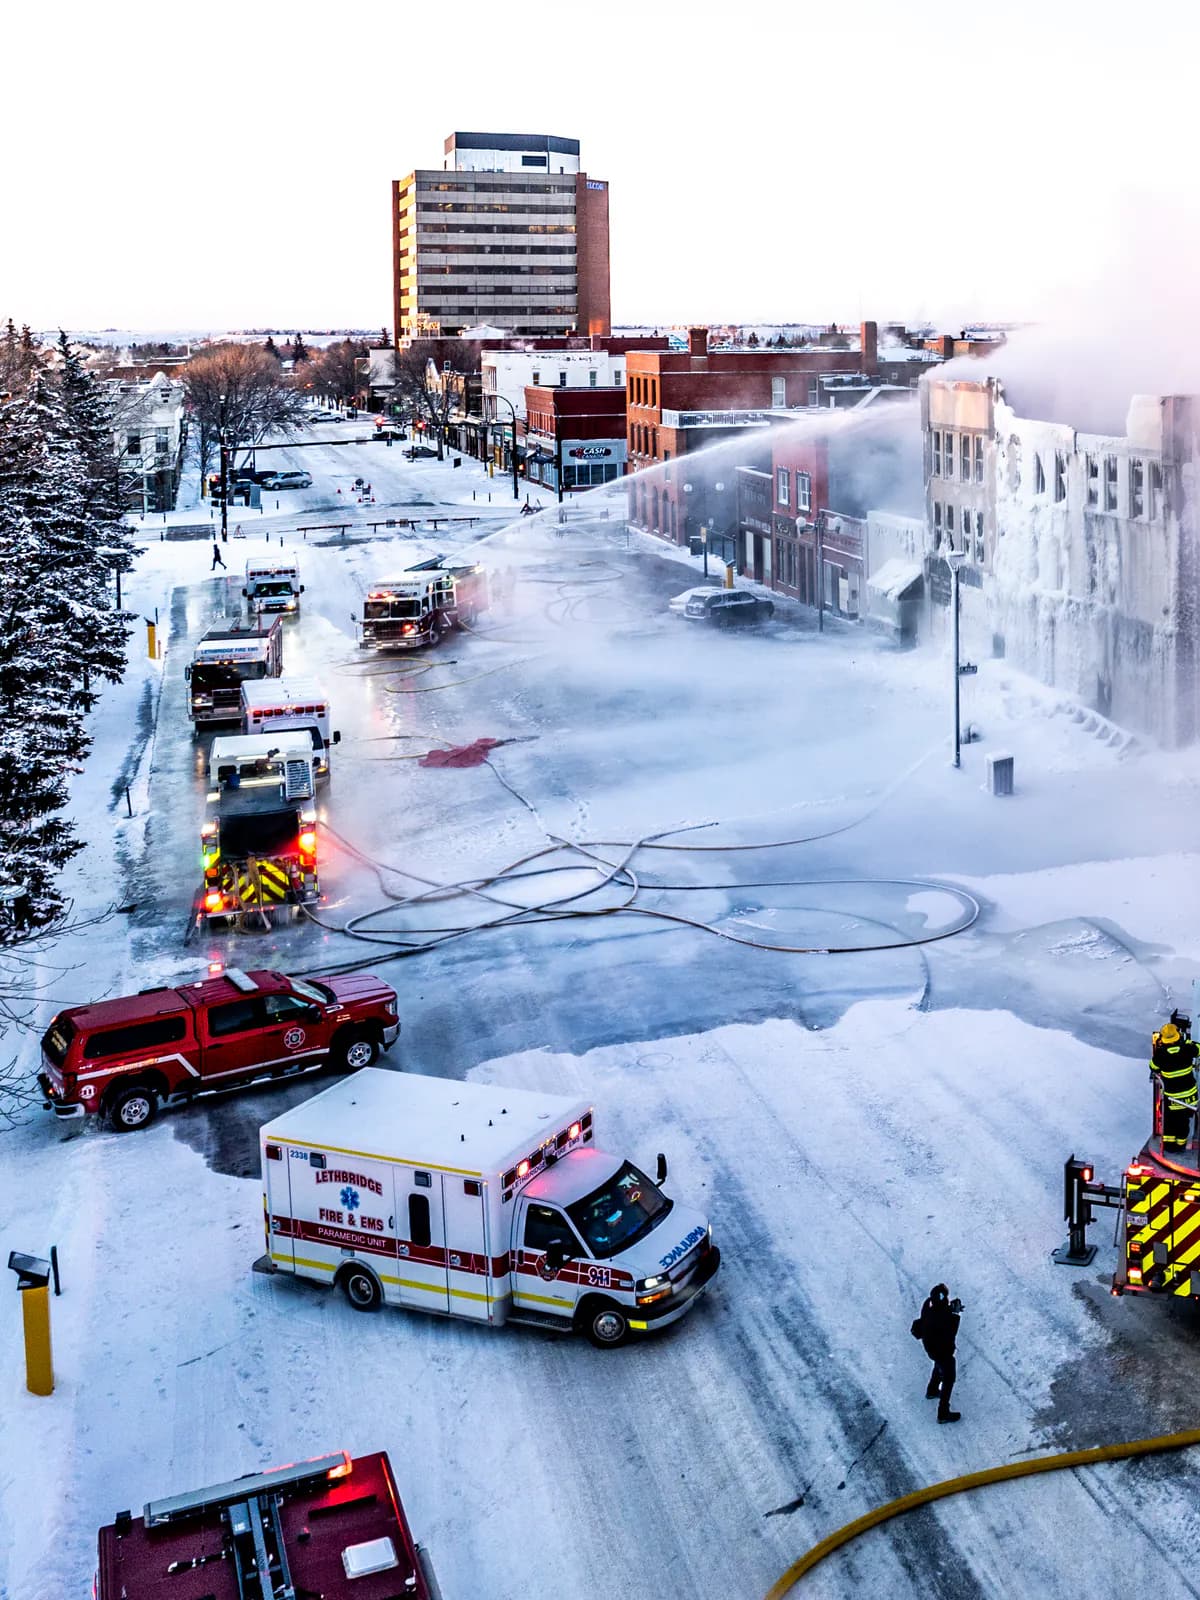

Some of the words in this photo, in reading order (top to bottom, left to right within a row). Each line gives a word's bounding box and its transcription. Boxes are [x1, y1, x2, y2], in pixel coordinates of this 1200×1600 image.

[583, 447, 606, 455] CASH
[315, 1170, 383, 1197] LETHBRIDGE
[318, 1207, 344, 1224] FIRE
[347, 1213, 356, 1226] &
[360, 1215, 384, 1231] EMS
[318, 1227, 366, 1243] PARAMEDIC
[367, 1238, 387, 1248] UNIT
[588, 1266, 612, 1288] 911
